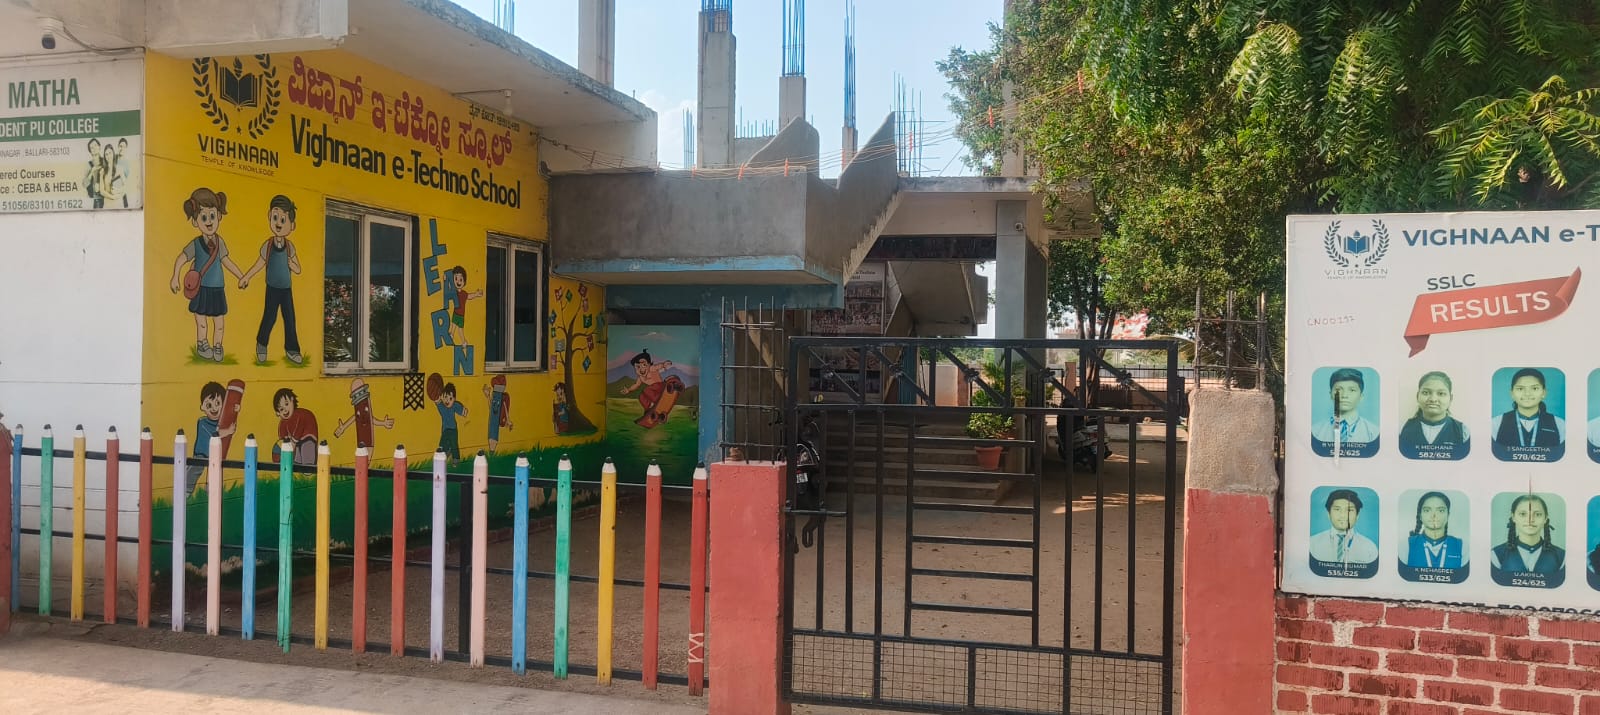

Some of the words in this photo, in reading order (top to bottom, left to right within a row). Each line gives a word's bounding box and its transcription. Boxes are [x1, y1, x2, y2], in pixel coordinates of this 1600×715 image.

[8, 78, 80, 108] MATHA
[30, 121, 45, 136] PU
[48, 118, 99, 135] COLLEGE
[197, 133, 279, 168] VIGHNAAN
[290, 114, 386, 176] Vighnaan
[471, 168, 521, 209] School
[20, 169, 55, 179] Courses
[17, 183, 42, 193] CEBA
[44, 183, 51, 193] &
[53, 182, 78, 192] HEBA
[2, 200, 54, 210] 51056/83101
[57, 199, 83, 210] 61622
[1402, 226, 1550, 247] VIGHNAAN
[1324, 268, 1388, 276] VIGHNAAN
[1427, 274, 1476, 291] SSLC
[423, 218, 474, 376] LEARN
[1430, 291, 1551, 323] RESULTS
[1512, 453, 1546, 461] 578/625
[1512, 578, 1546, 586] 524/625
